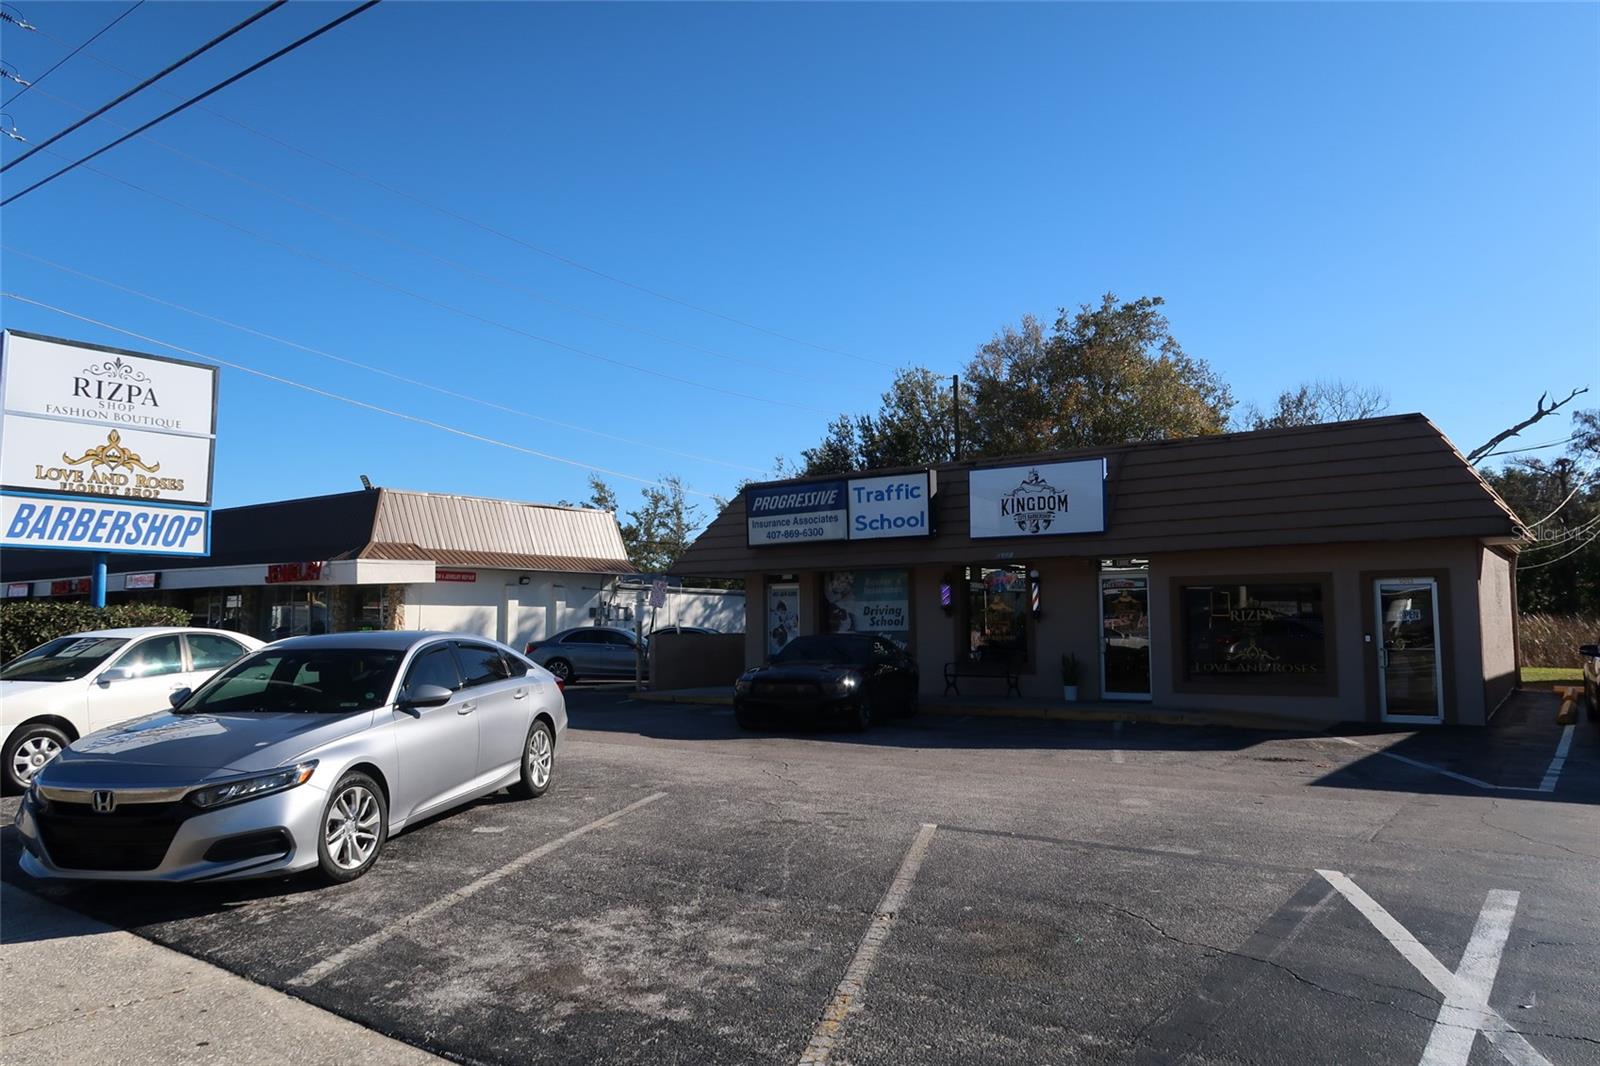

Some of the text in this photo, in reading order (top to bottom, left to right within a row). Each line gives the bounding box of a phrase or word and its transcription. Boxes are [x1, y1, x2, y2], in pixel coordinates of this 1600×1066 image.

[72, 376, 160, 407] RIZPA
[98, 401, 135, 412] SHOP
[46, 404, 182, 429] FASHION BOUTIQUE
[35, 465, 185, 492] LOVE AND ROSES
[60, 482, 161, 499] FLORIST SHOP
[853, 483, 922, 503] Traffic
[752, 489, 839, 512] PROGRESSIVE
[1001, 494, 1068, 517] KINGDOM
[6, 503, 203, 548] BARBERSHOP
[752, 514, 839, 529] Insurance Associates
[855, 511, 925, 531] School
[766, 527, 824, 540] 407-869-6300
[863, 605, 903, 617] Driving
[1230, 607, 1276, 623] RIZPA
[869, 616, 905, 627] School
[1272, 662, 1318, 673] ROSES
